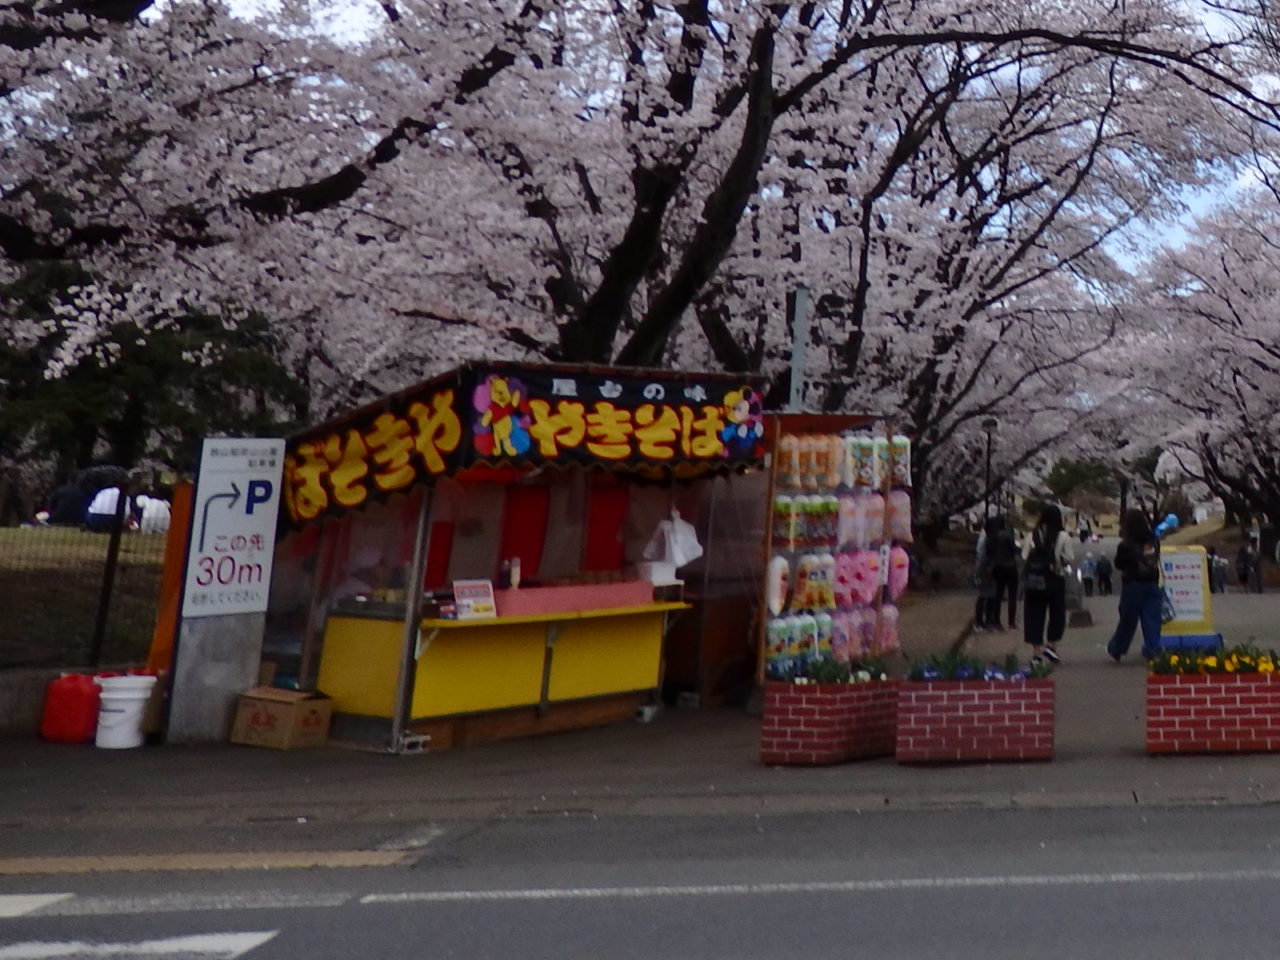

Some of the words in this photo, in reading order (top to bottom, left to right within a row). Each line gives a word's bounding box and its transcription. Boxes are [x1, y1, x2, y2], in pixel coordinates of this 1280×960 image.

[529, 399, 726, 459] やきそば
[245, 479, 273, 515] P
[214, 533, 266, 553] この先
[195, 555, 263, 587] 30m
